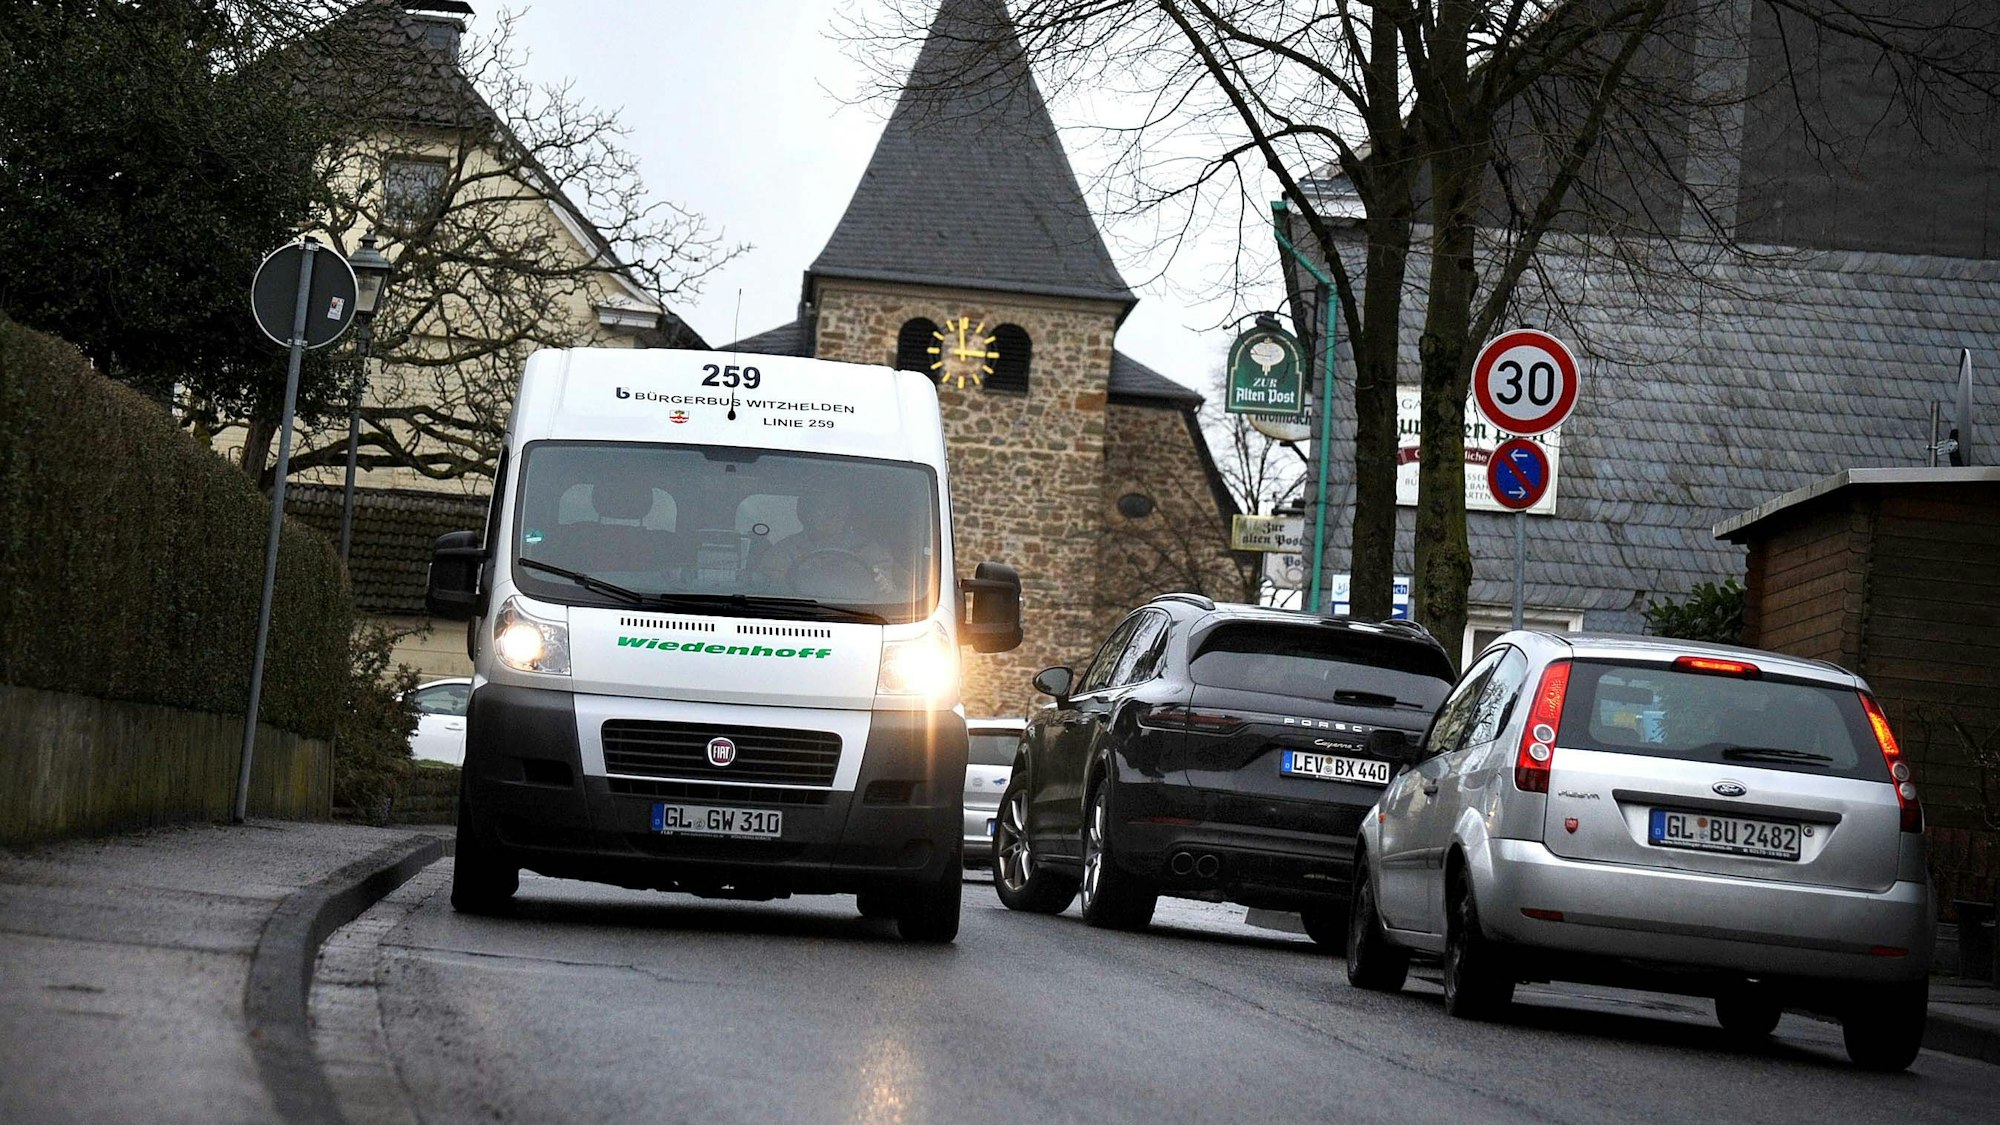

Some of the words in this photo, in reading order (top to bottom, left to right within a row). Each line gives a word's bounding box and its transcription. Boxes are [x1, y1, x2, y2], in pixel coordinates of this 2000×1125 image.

[701, 364, 761, 389] 259
[1252, 377, 1278, 388] ZUR
[1496, 360, 1555, 406] 30
[634, 391, 741, 407] BÜRGERBUS
[746, 399, 855, 414] WITZHELDEN
[1235, 387, 1266, 403] Alten
[1267, 388, 1296, 405] Post
[763, 418, 803, 428] LINIE
[808, 419, 835, 428] 259
[1274, 534, 1303, 547] Pos
[617, 636, 831, 658] Wiedenhoff
[1284, 718, 1372, 733] PORSC
[713, 745, 731, 760] FIAT
[1314, 738, 1352, 749] Cayenne
[1351, 744, 1364, 752] S
[1293, 754, 1324, 774] LEV
[1335, 758, 1355, 777] BX
[1358, 761, 1387, 781] 440
[665, 807, 692, 828] GL
[707, 809, 735, 831] GW
[740, 811, 780, 833] 310
[1667, 815, 1694, 839] GL
[1710, 819, 1737, 844] BU
[1743, 823, 1796, 851] 2482
